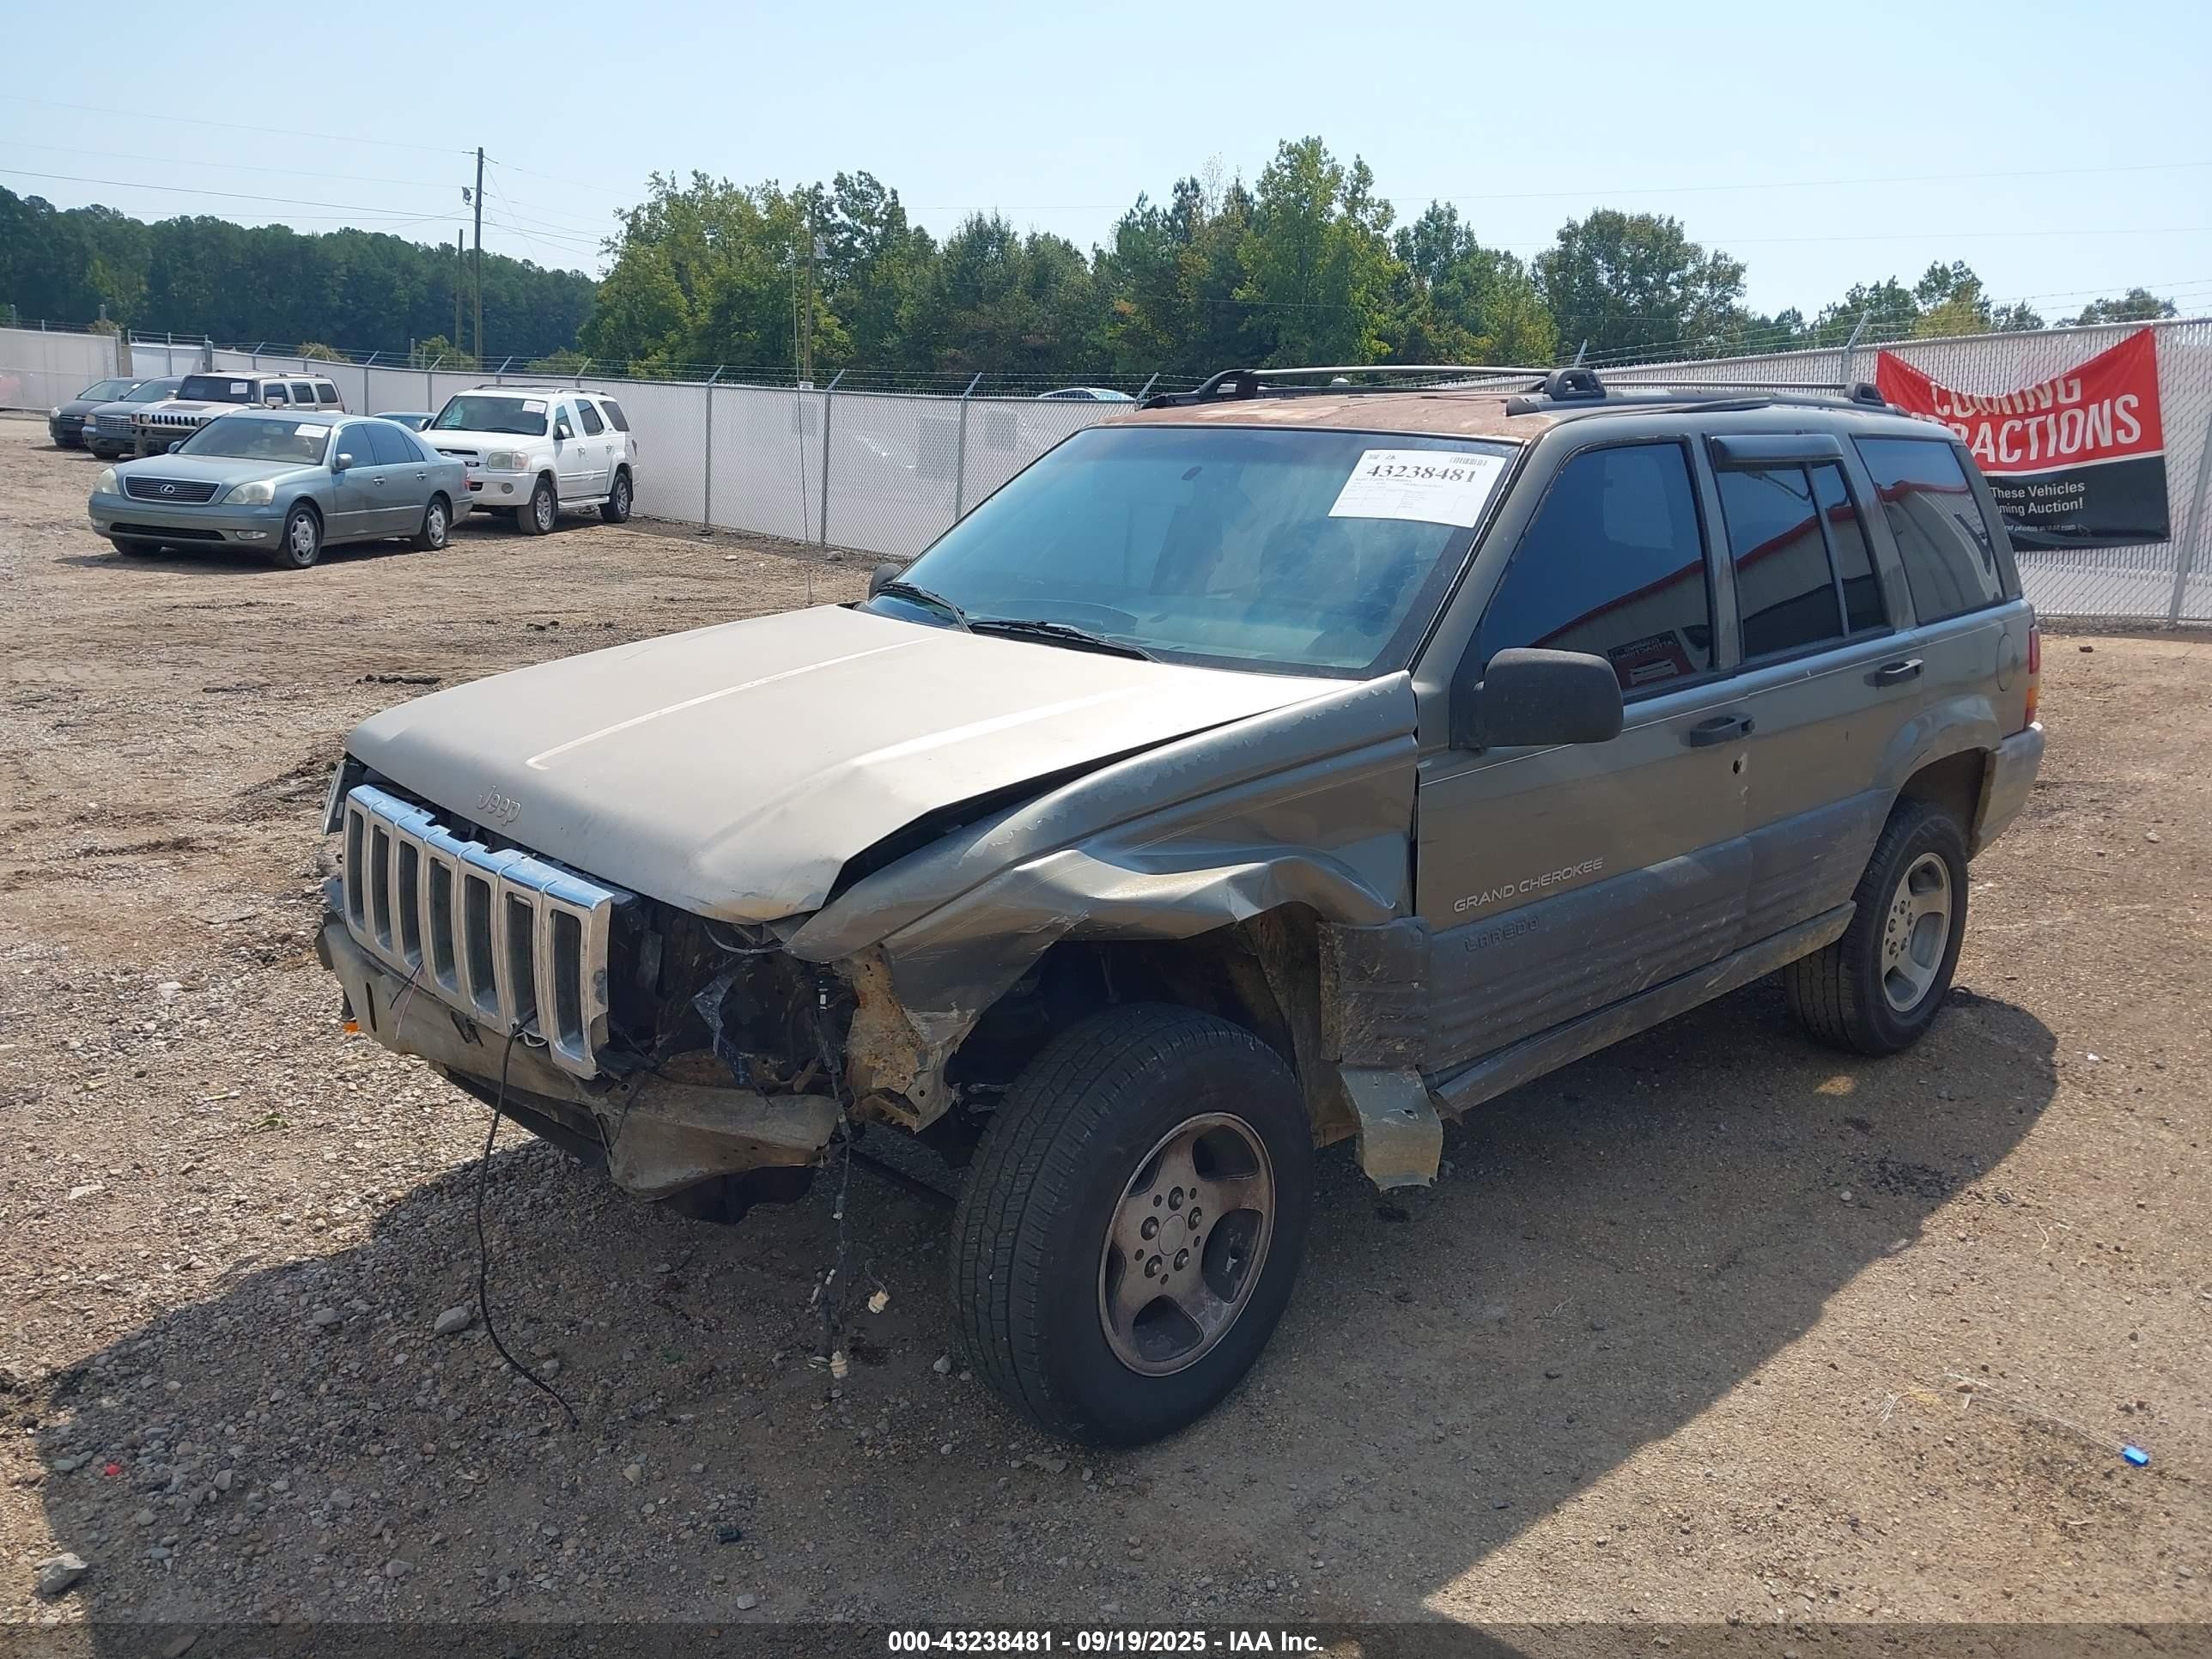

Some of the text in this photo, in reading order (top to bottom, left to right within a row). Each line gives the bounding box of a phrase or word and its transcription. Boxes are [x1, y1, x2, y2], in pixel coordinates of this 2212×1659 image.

[1911, 394, 2142, 464] RACTIONS
[1366, 464, 1476, 483] 43238481
[1990, 482, 2086, 499] These Vehicles
[1998, 496, 2084, 517] ming Auction!
[476, 785, 522, 826] Jeep
[1453, 858, 1604, 913] GRAND CHEROKEE
[1464, 915, 1540, 952] LAREDO
